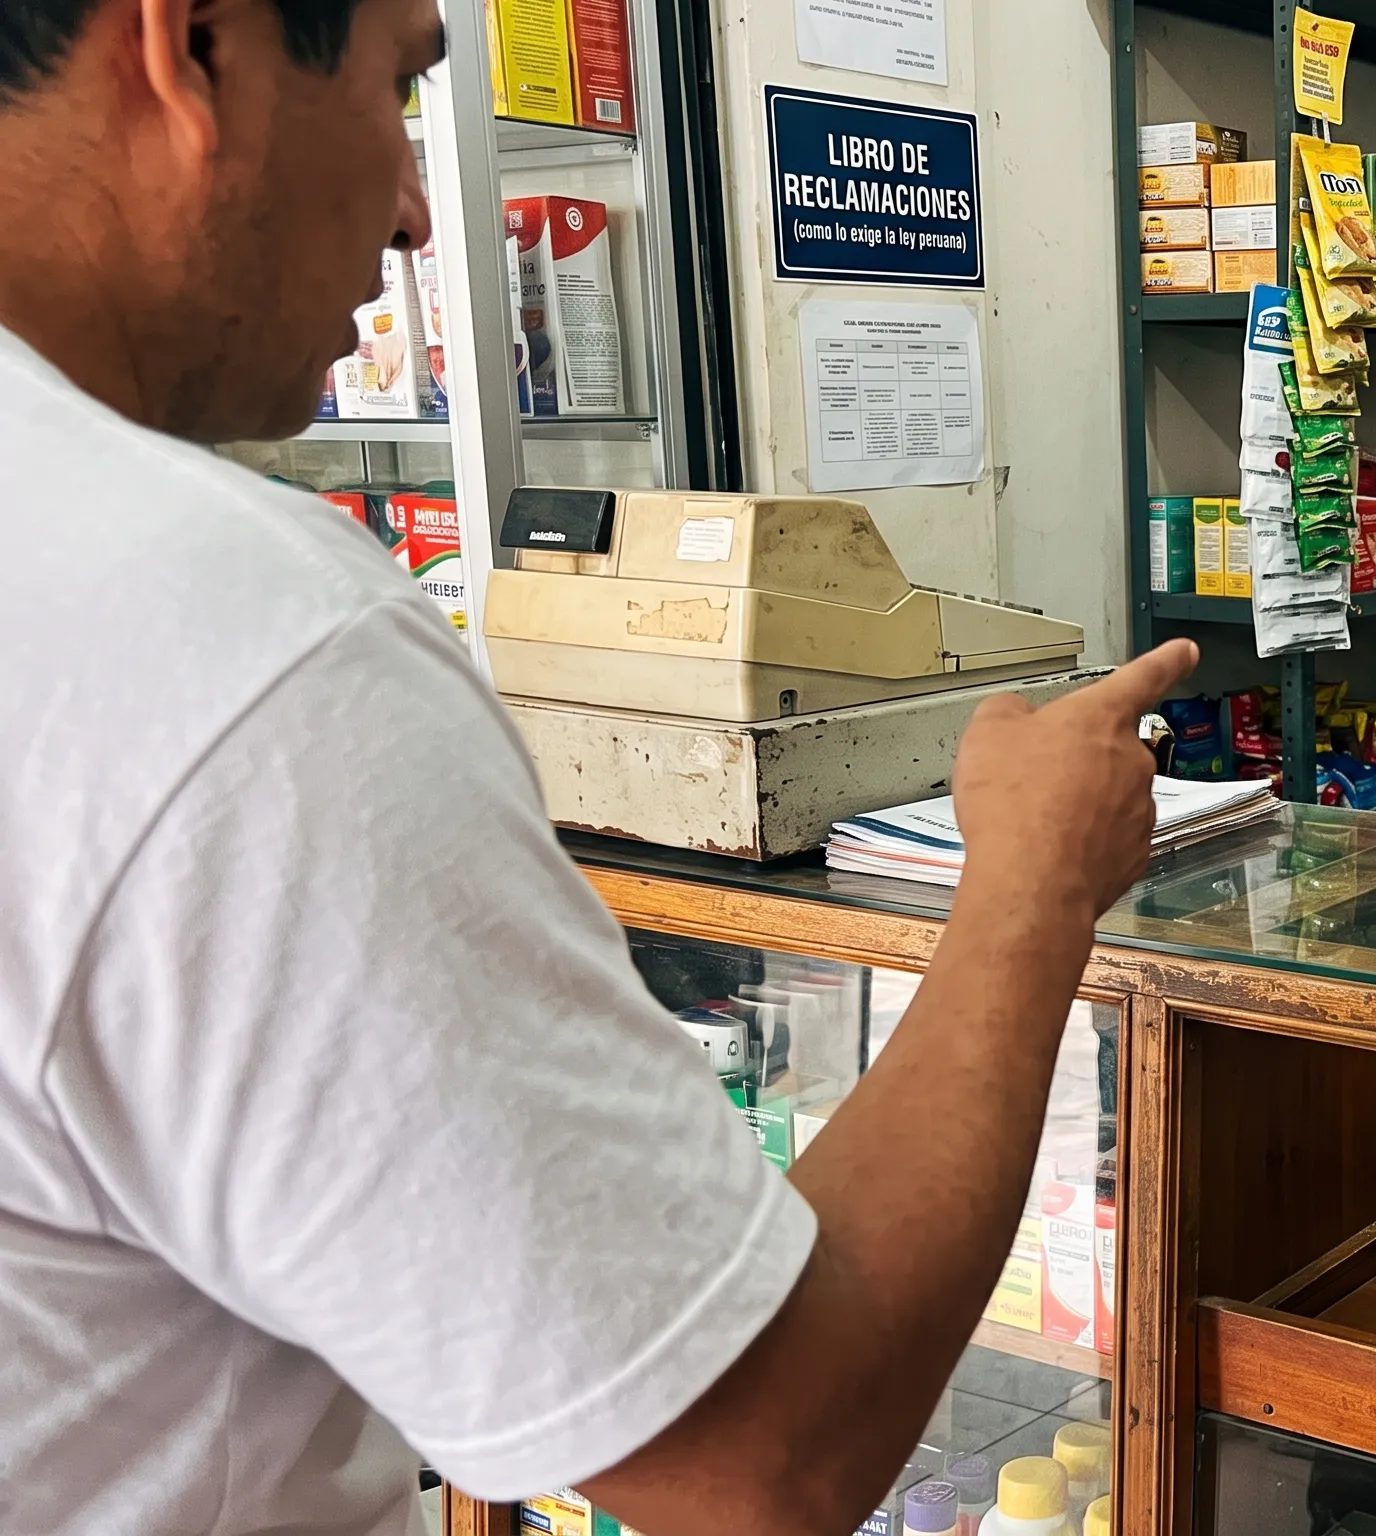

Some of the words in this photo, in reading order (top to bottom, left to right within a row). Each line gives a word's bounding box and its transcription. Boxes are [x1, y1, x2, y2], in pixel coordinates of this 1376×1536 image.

[828, 133, 895, 172] LIBRO
[901, 142, 930, 175] DE
[784, 172, 971, 221] RECLAMACIONES
[793, 218, 832, 243] (como
[836, 222, 847, 241] lo
[850, 224, 882, 247] exige
[885, 226, 896, 244] la
[899, 228, 916, 250] ley
[919, 231, 967, 254] peruana)
